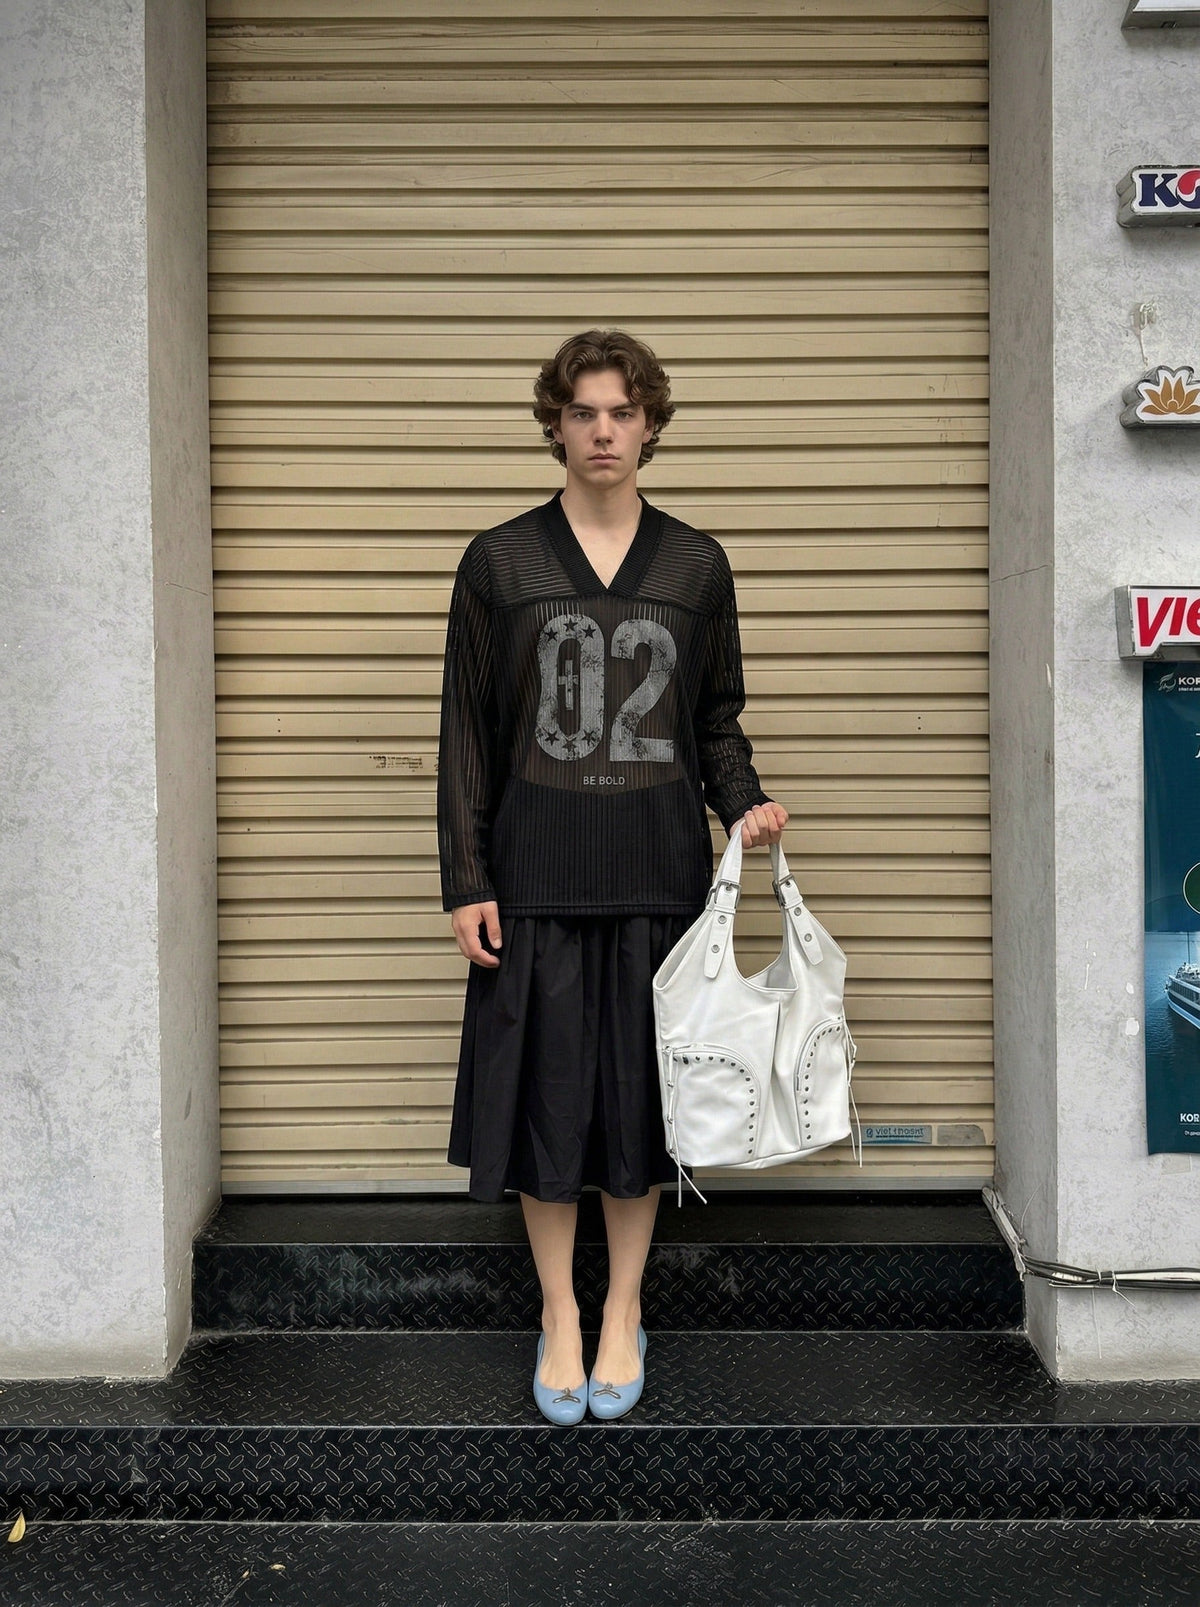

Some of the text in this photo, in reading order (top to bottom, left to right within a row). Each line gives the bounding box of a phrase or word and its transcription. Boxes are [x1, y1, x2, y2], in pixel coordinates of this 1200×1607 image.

[535, 613, 677, 763] 02
[583, 776, 625, 785] BE BOLD
